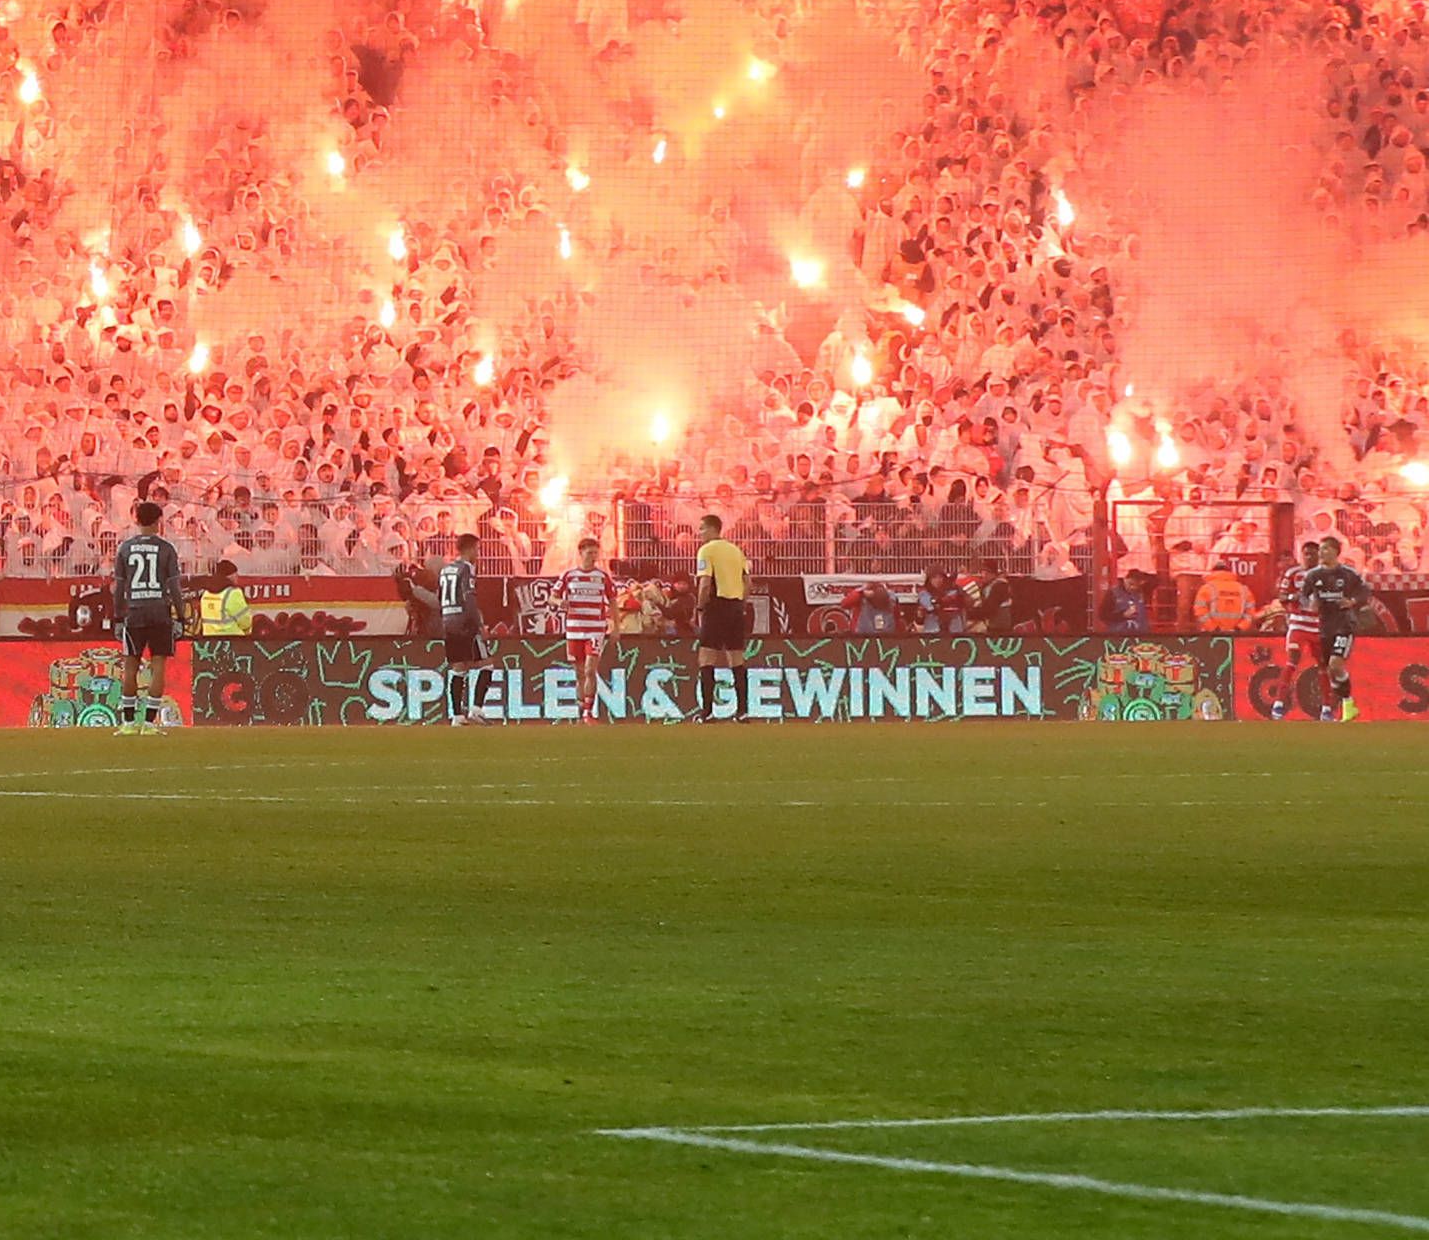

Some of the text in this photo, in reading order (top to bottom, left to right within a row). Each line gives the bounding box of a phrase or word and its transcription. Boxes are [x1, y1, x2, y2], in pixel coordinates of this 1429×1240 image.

[128, 553, 160, 590] 21
[1228, 557, 1258, 576] Tor
[645, 668, 687, 720] &
